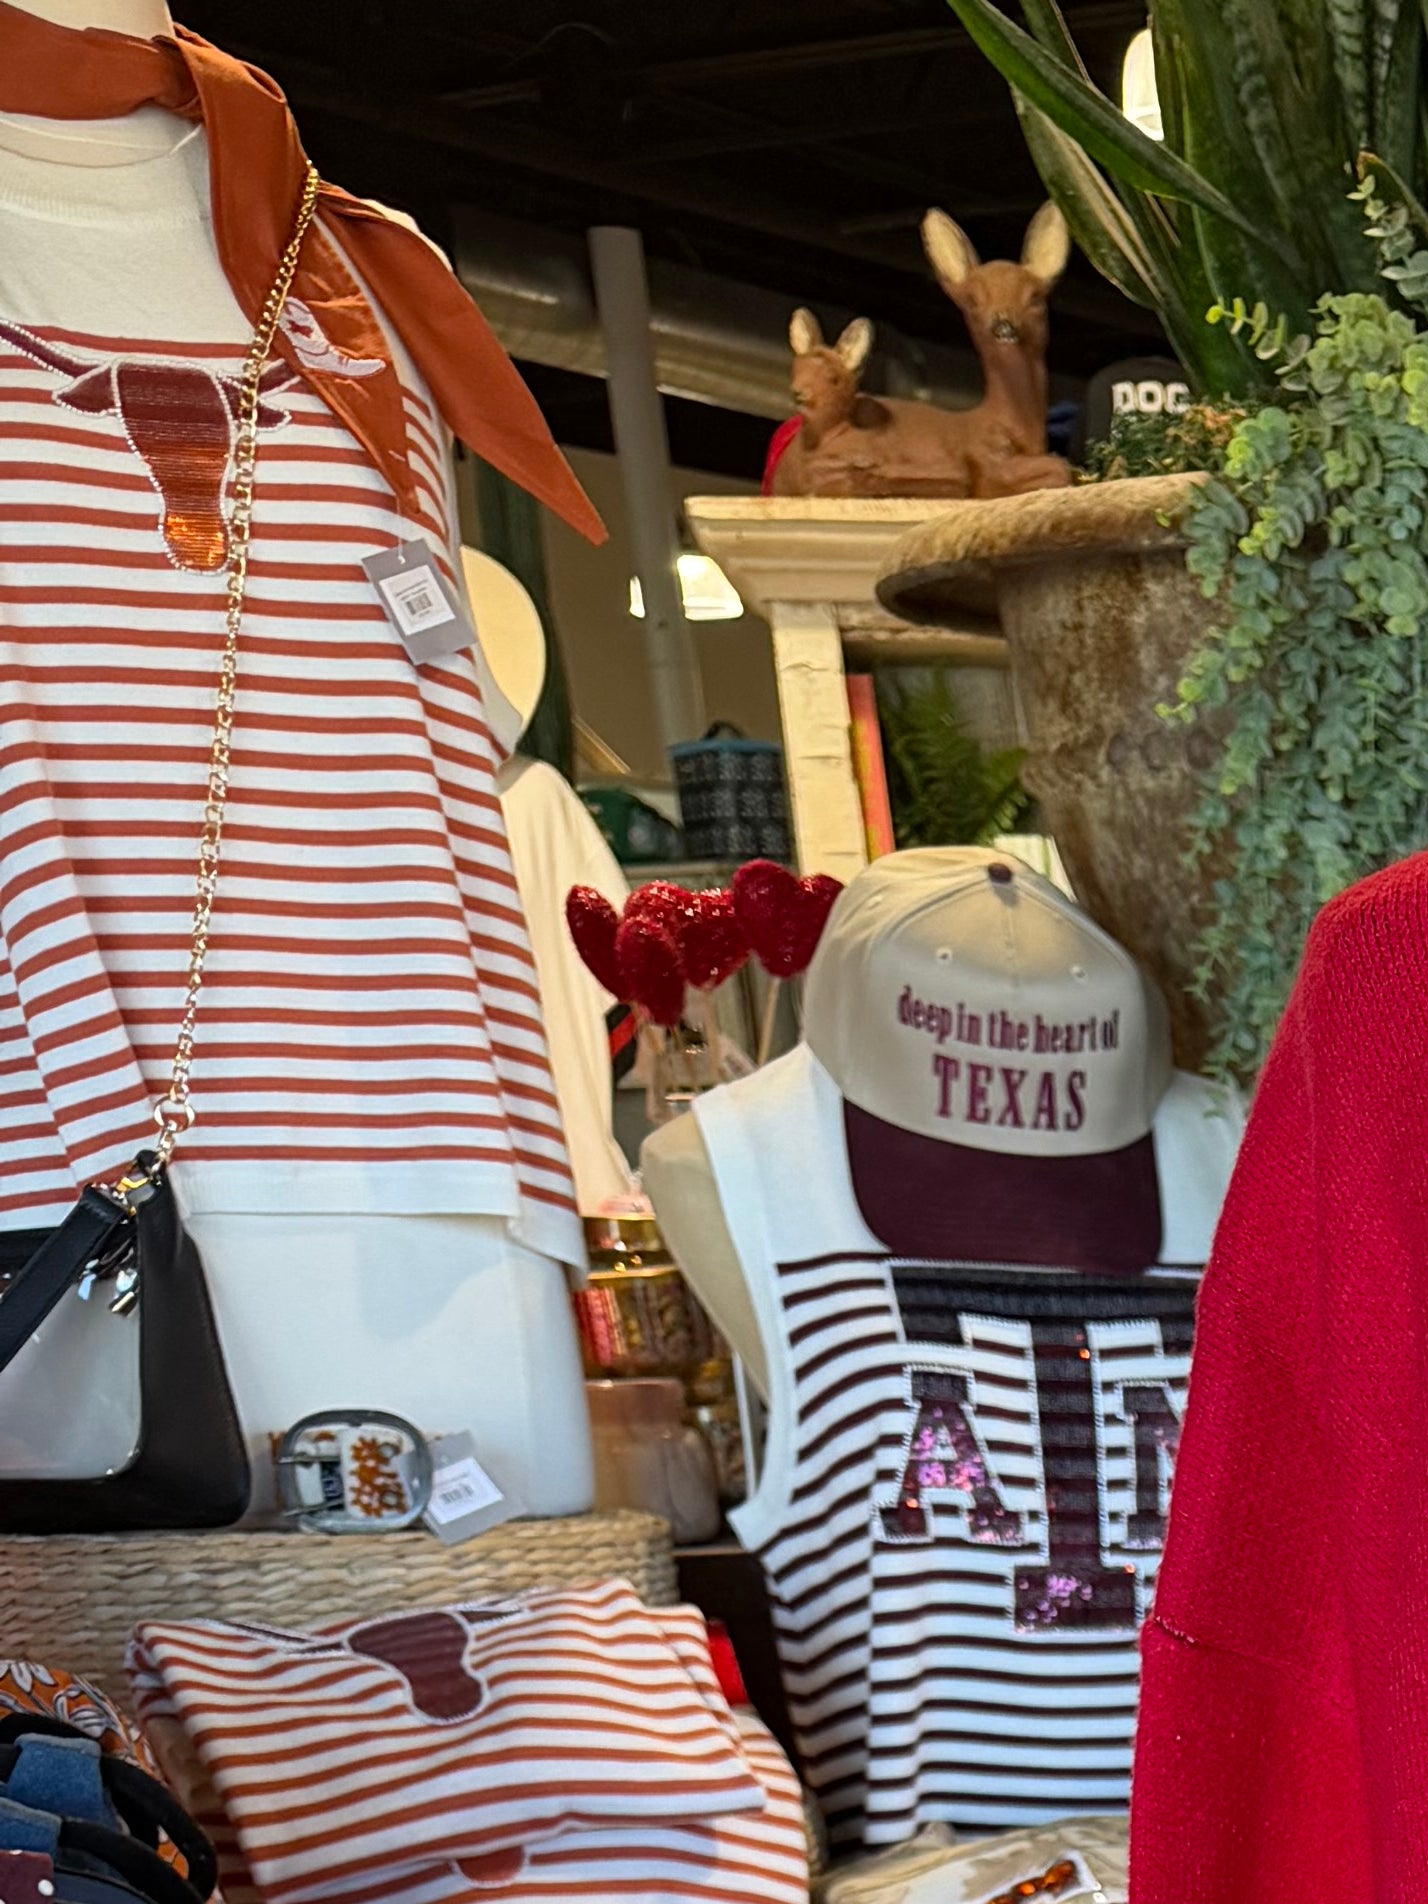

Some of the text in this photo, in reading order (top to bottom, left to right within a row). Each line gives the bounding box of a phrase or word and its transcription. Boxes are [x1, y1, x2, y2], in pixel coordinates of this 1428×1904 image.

[897, 984, 1121, 1053] deep in the heart of
[931, 1052, 1087, 1132] TEXAS
